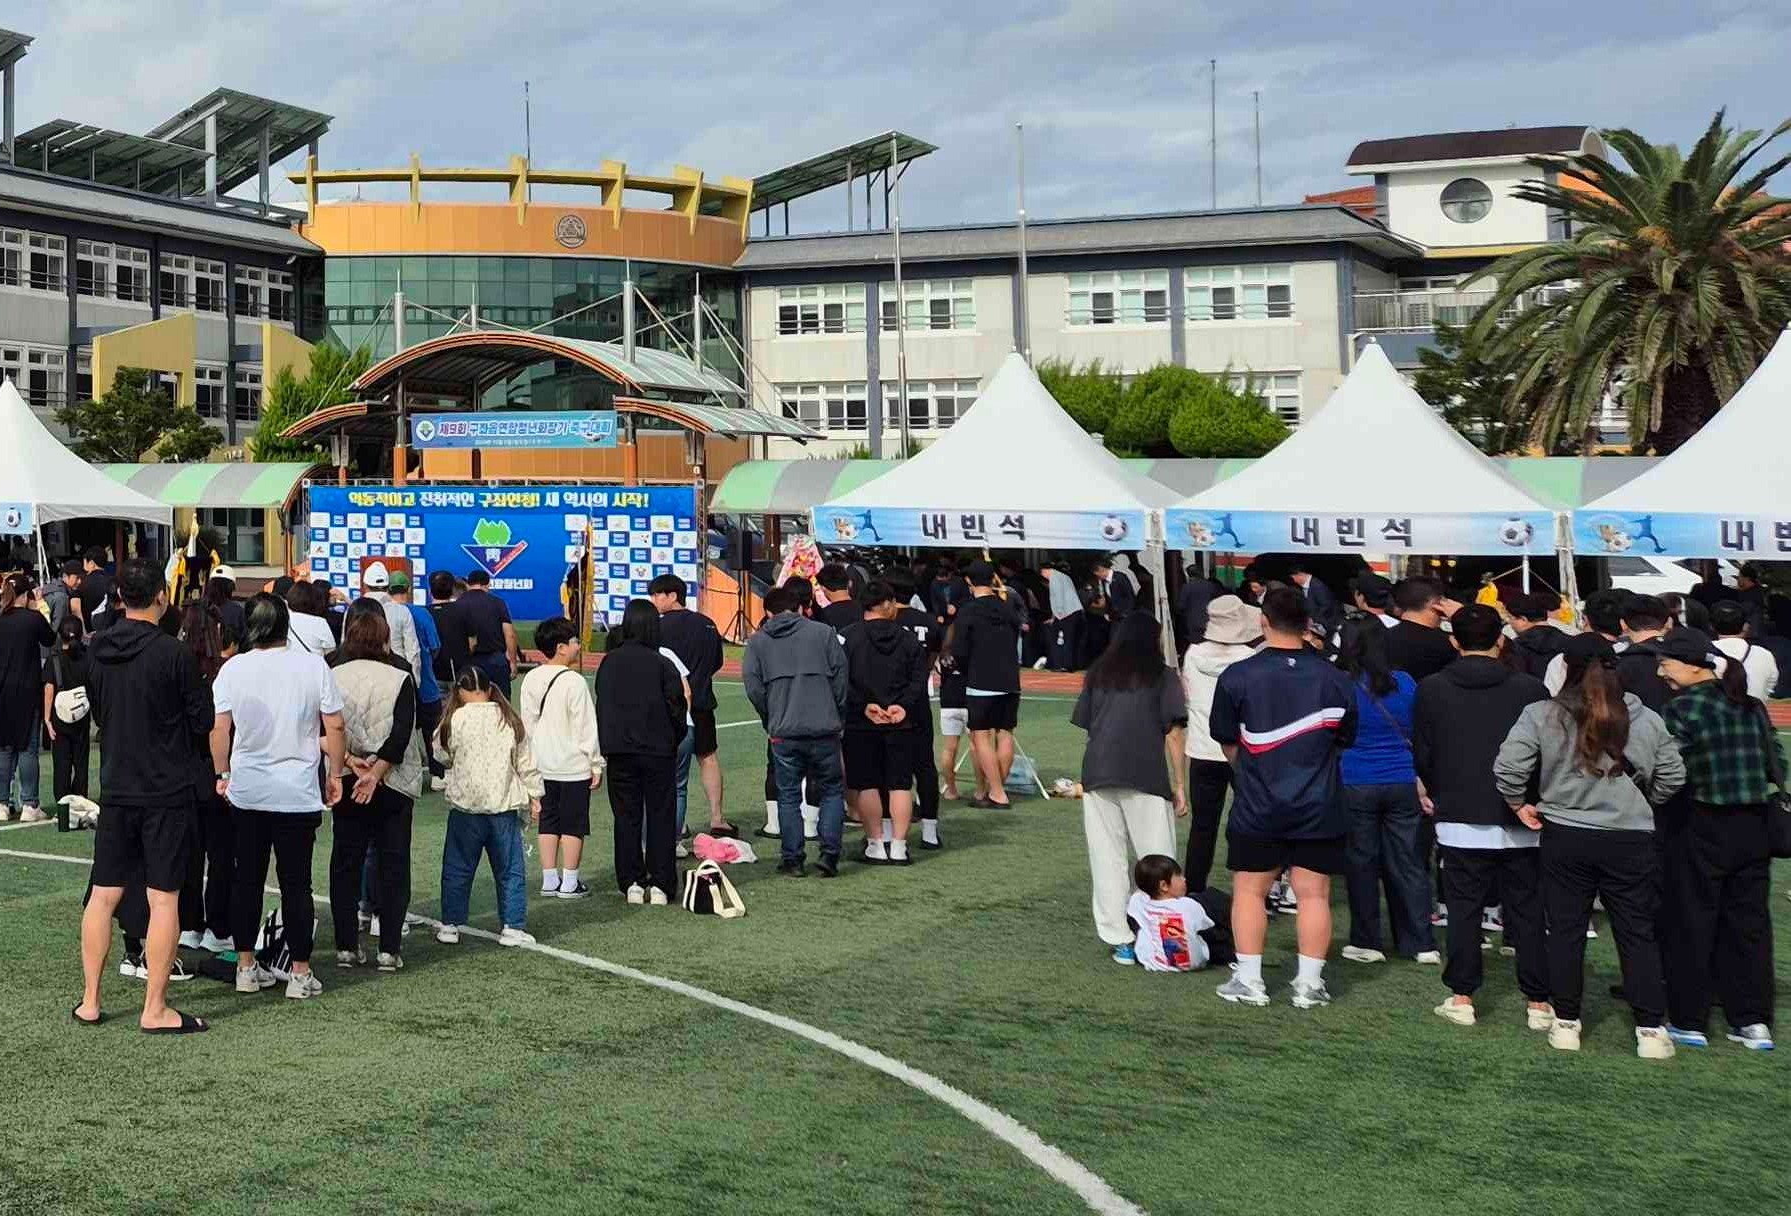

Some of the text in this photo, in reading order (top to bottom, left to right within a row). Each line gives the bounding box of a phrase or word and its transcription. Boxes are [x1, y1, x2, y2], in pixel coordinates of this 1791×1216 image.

[419, 491, 475, 508] 진취적인
[544, 491, 560, 508] 새
[563, 491, 608, 508] 역사의
[612, 491, 649, 508] 시작!
[921, 512, 1026, 542] 내빈석
[1289, 517, 1413, 547] 내빈석
